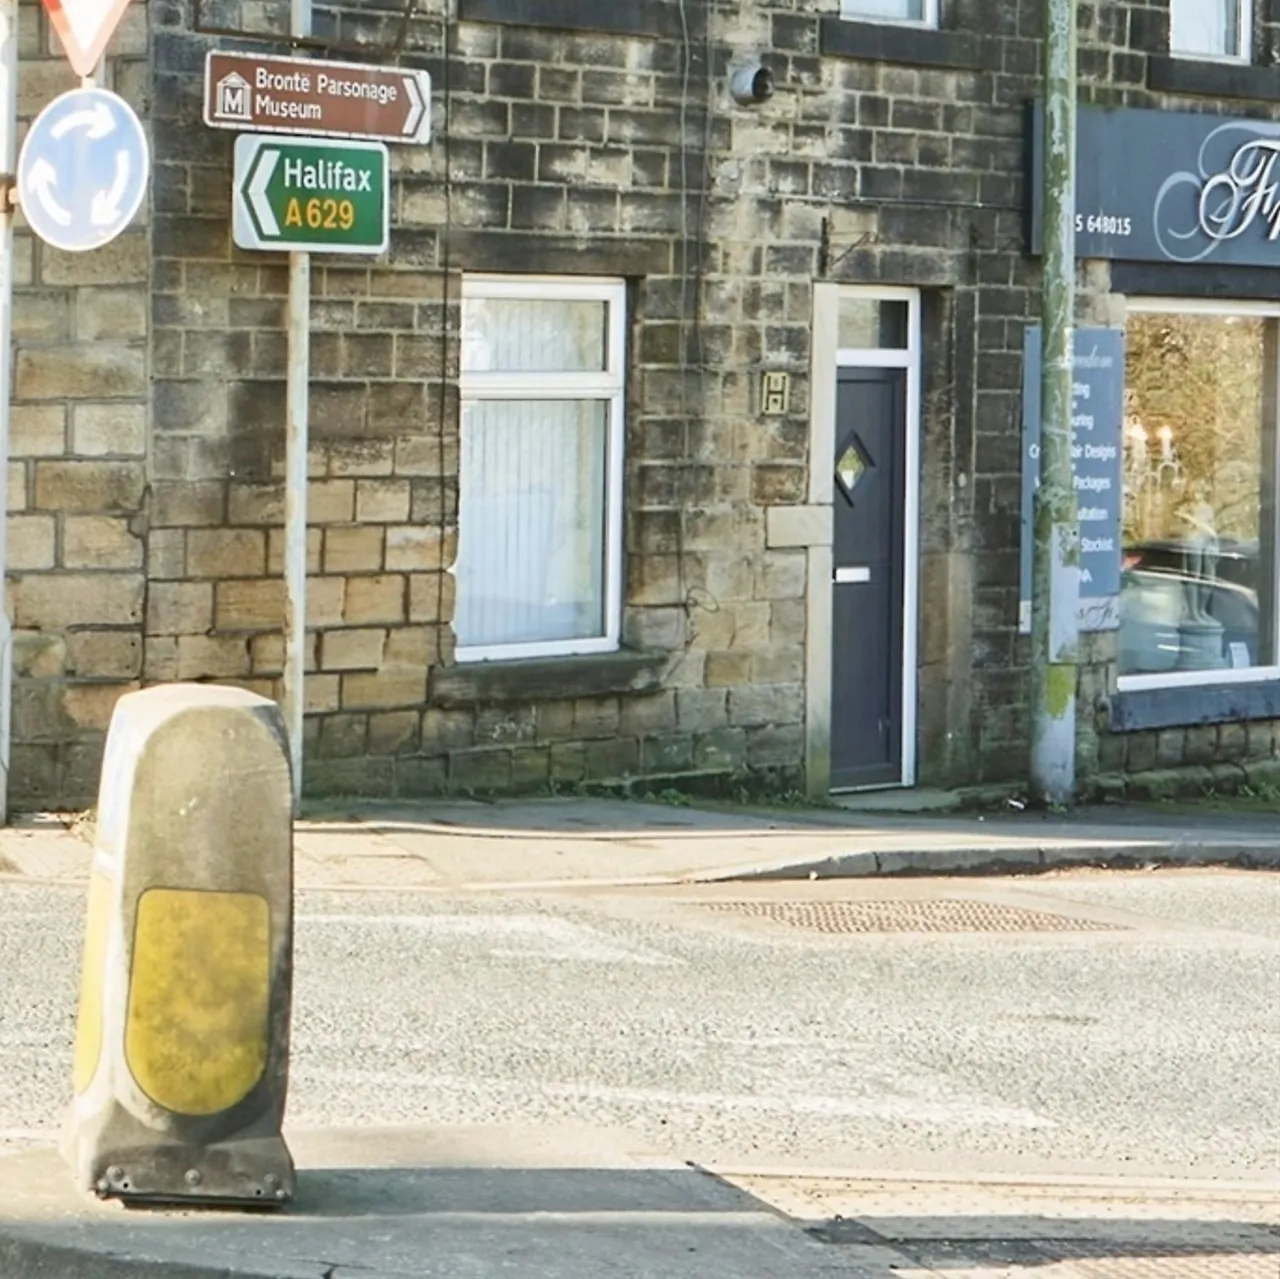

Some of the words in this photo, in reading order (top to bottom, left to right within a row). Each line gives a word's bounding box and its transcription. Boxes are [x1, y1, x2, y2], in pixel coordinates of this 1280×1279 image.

[256, 67, 310, 93] Brontë
[318, 74, 397, 104] Parsonage
[255, 95, 322, 119] Museum
[284, 157, 372, 192] Halifax
